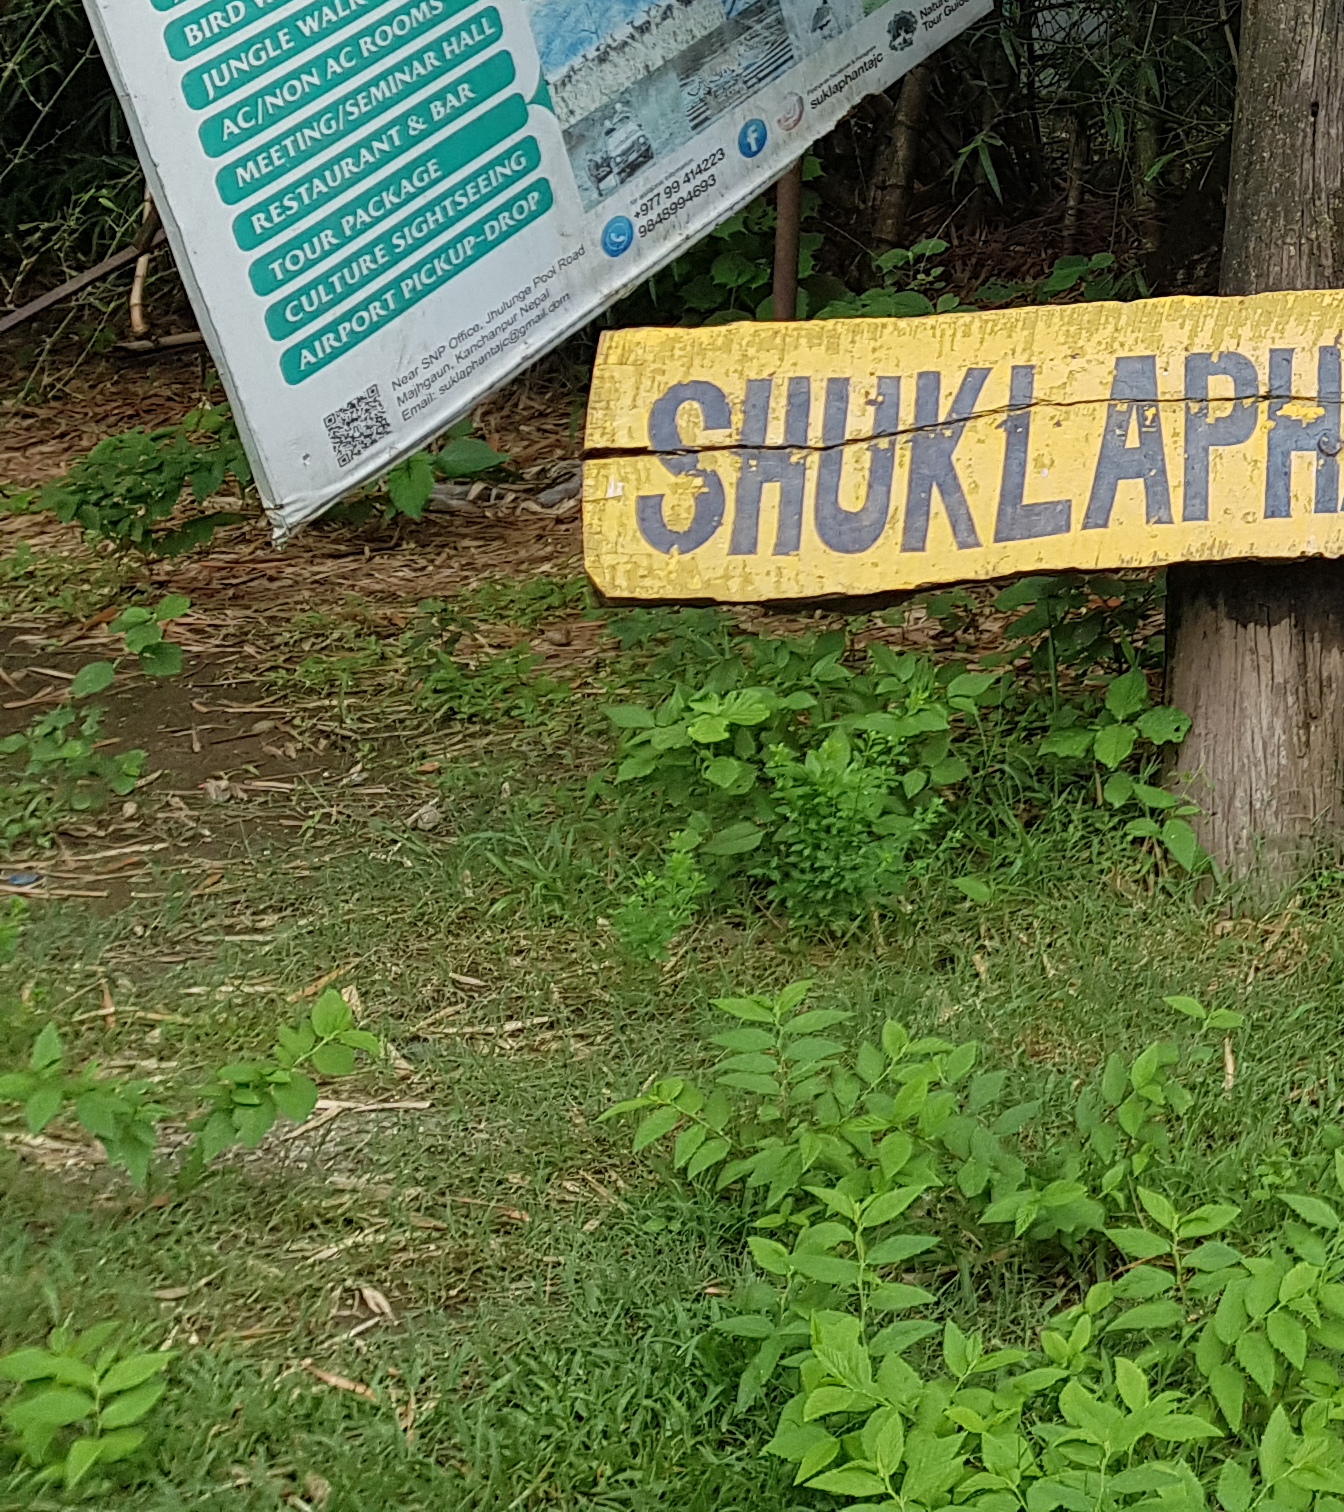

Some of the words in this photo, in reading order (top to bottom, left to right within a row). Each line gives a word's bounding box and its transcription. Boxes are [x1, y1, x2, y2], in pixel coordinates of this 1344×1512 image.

[184, 0, 246, 48] BIRD
[202, 28, 294, 101] JUNGLE
[220, 71, 321, 142] AC/NON
[326, 45, 357, 80] AC
[234, 52, 442, 189] MEETING/SEMINAR
[443, 16, 496, 58] HALL
[250, 128, 402, 236] RESTAURANT
[406, 113, 429, 137] &
[429, 82, 477, 123] BAR
[268, 230, 340, 282] TOUR
[342, 157, 444, 237] PACKAGE
[633, 192, 662, 220] +977
[663, 179, 680, 200] 99
[682, 147, 726, 186] 414223
[284, 248, 390, 324] CULTURE
[391, 149, 528, 254] SIGHTSEEING
[298, 292, 397, 372] AIRPORT
[399, 192, 541, 300] PICKUP-DROP
[391, 366, 420, 392] Near
[421, 345, 446, 370] SNP
[557, 243, 586, 271] Road
[520, 288, 551, 318] Nepal
